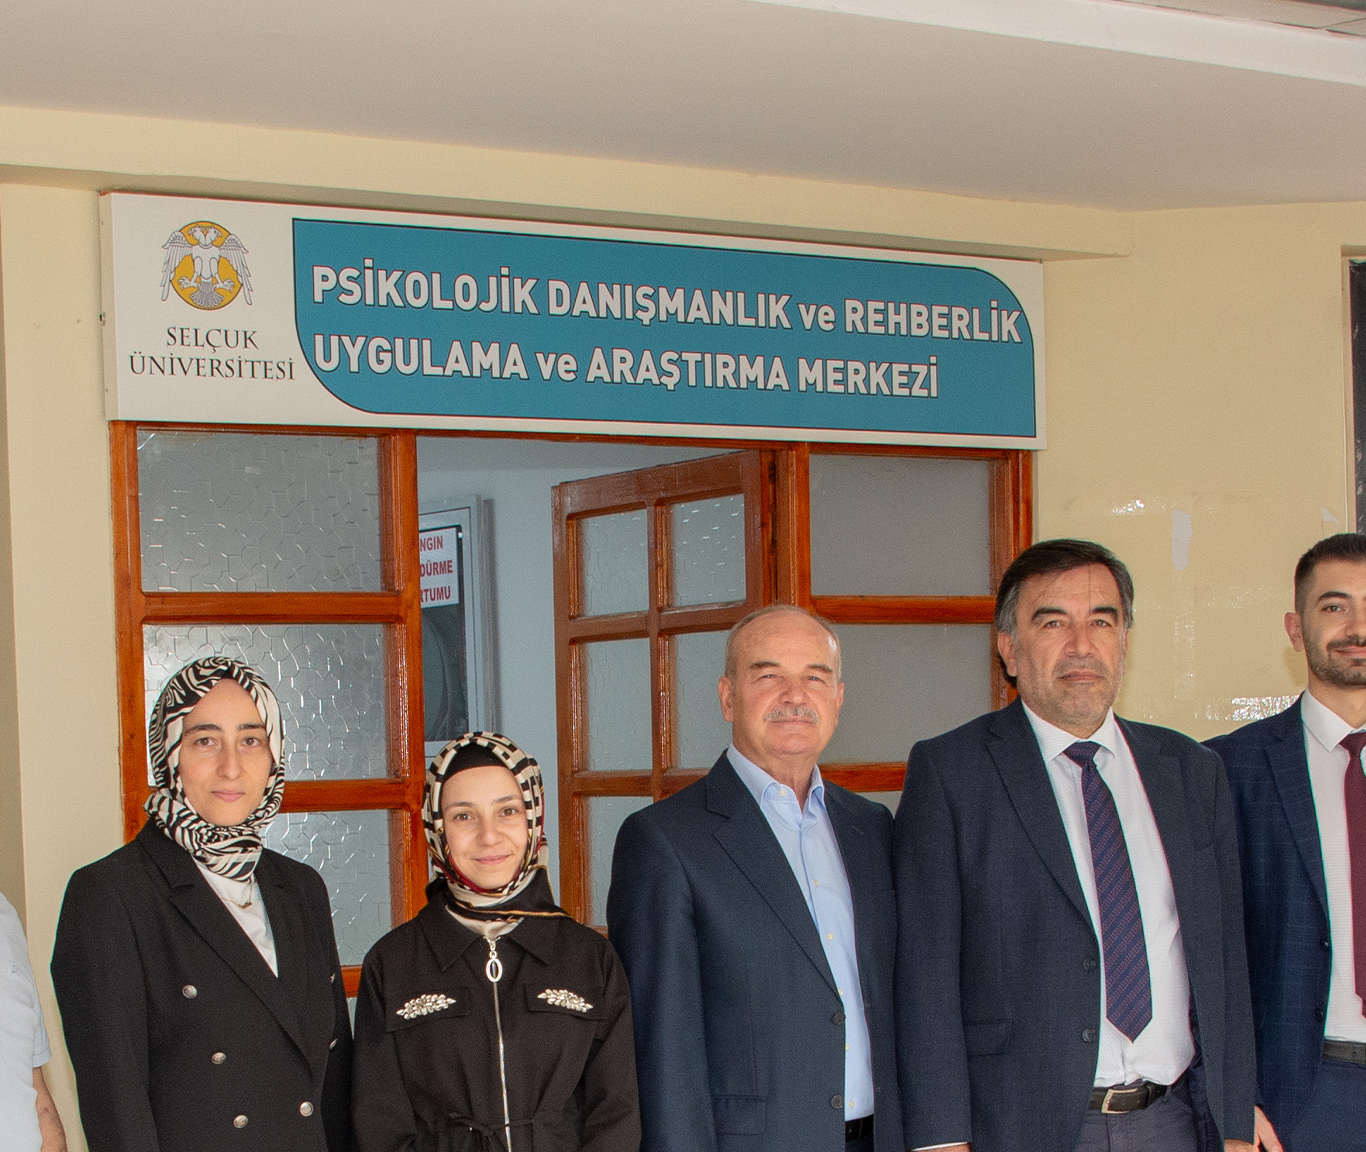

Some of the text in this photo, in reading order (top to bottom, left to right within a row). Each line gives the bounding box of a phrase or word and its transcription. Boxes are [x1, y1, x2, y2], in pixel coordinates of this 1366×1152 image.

[312, 257, 1023, 344] PSİKOLOJİK DANIŞMANLIK ve REHBERLİK
[166, 326, 259, 353] SELÇUK
[129, 351, 296, 381] ÜNİVERSİTESİ
[313, 333, 939, 399] UYGULAMA ve ARAŞTIRMA MERKEZİ
